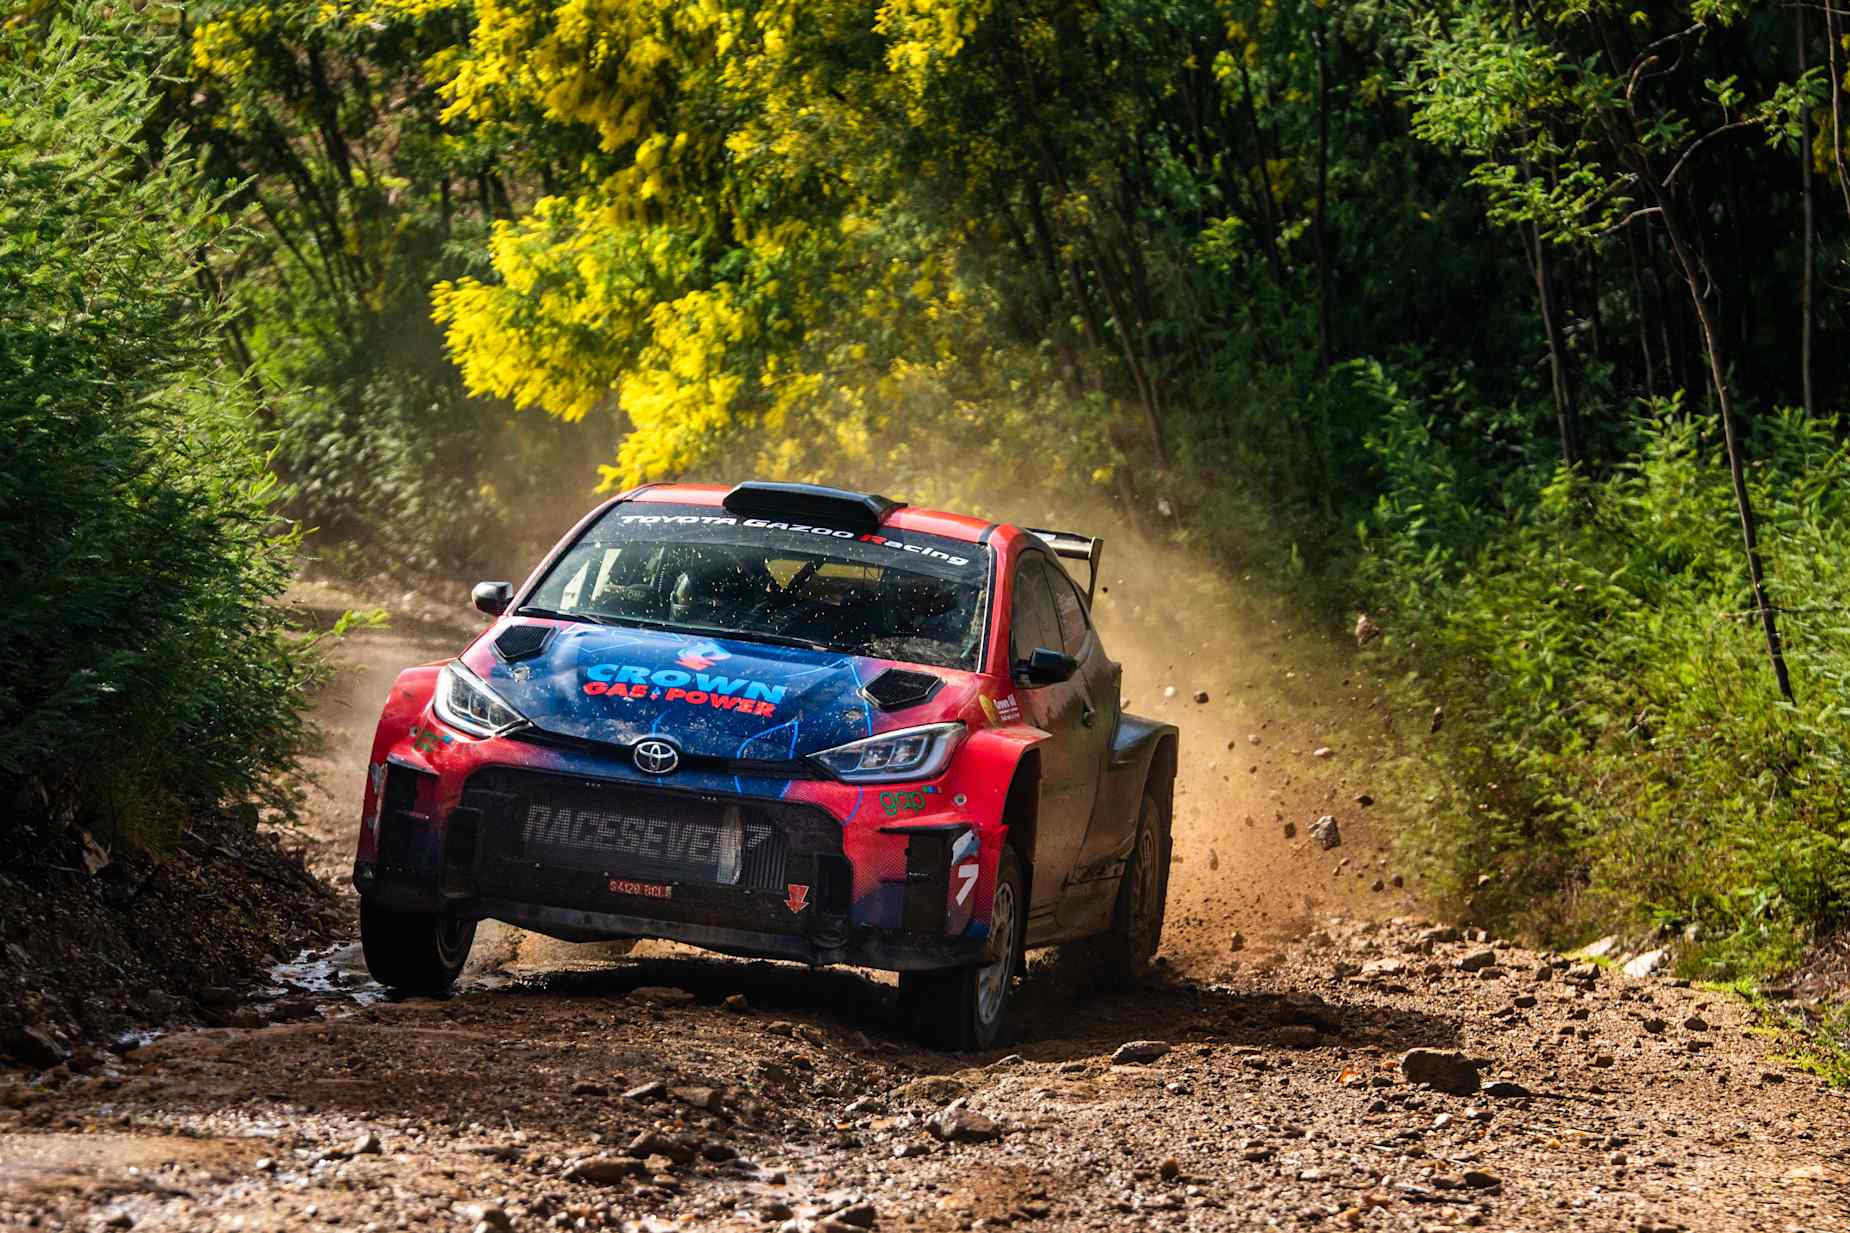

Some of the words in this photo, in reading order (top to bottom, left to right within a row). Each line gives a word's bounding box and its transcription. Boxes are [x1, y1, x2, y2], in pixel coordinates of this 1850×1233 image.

[619, 515, 737, 526] TOYOTA
[741, 518, 855, 539] GAZOO
[858, 533, 970, 566] Racing
[583, 681, 649, 699] GAS
[665, 687, 776, 718] POWER
[587, 663, 788, 705] CROWN
[880, 791, 926, 815] gap
[956, 864, 979, 906] 7
